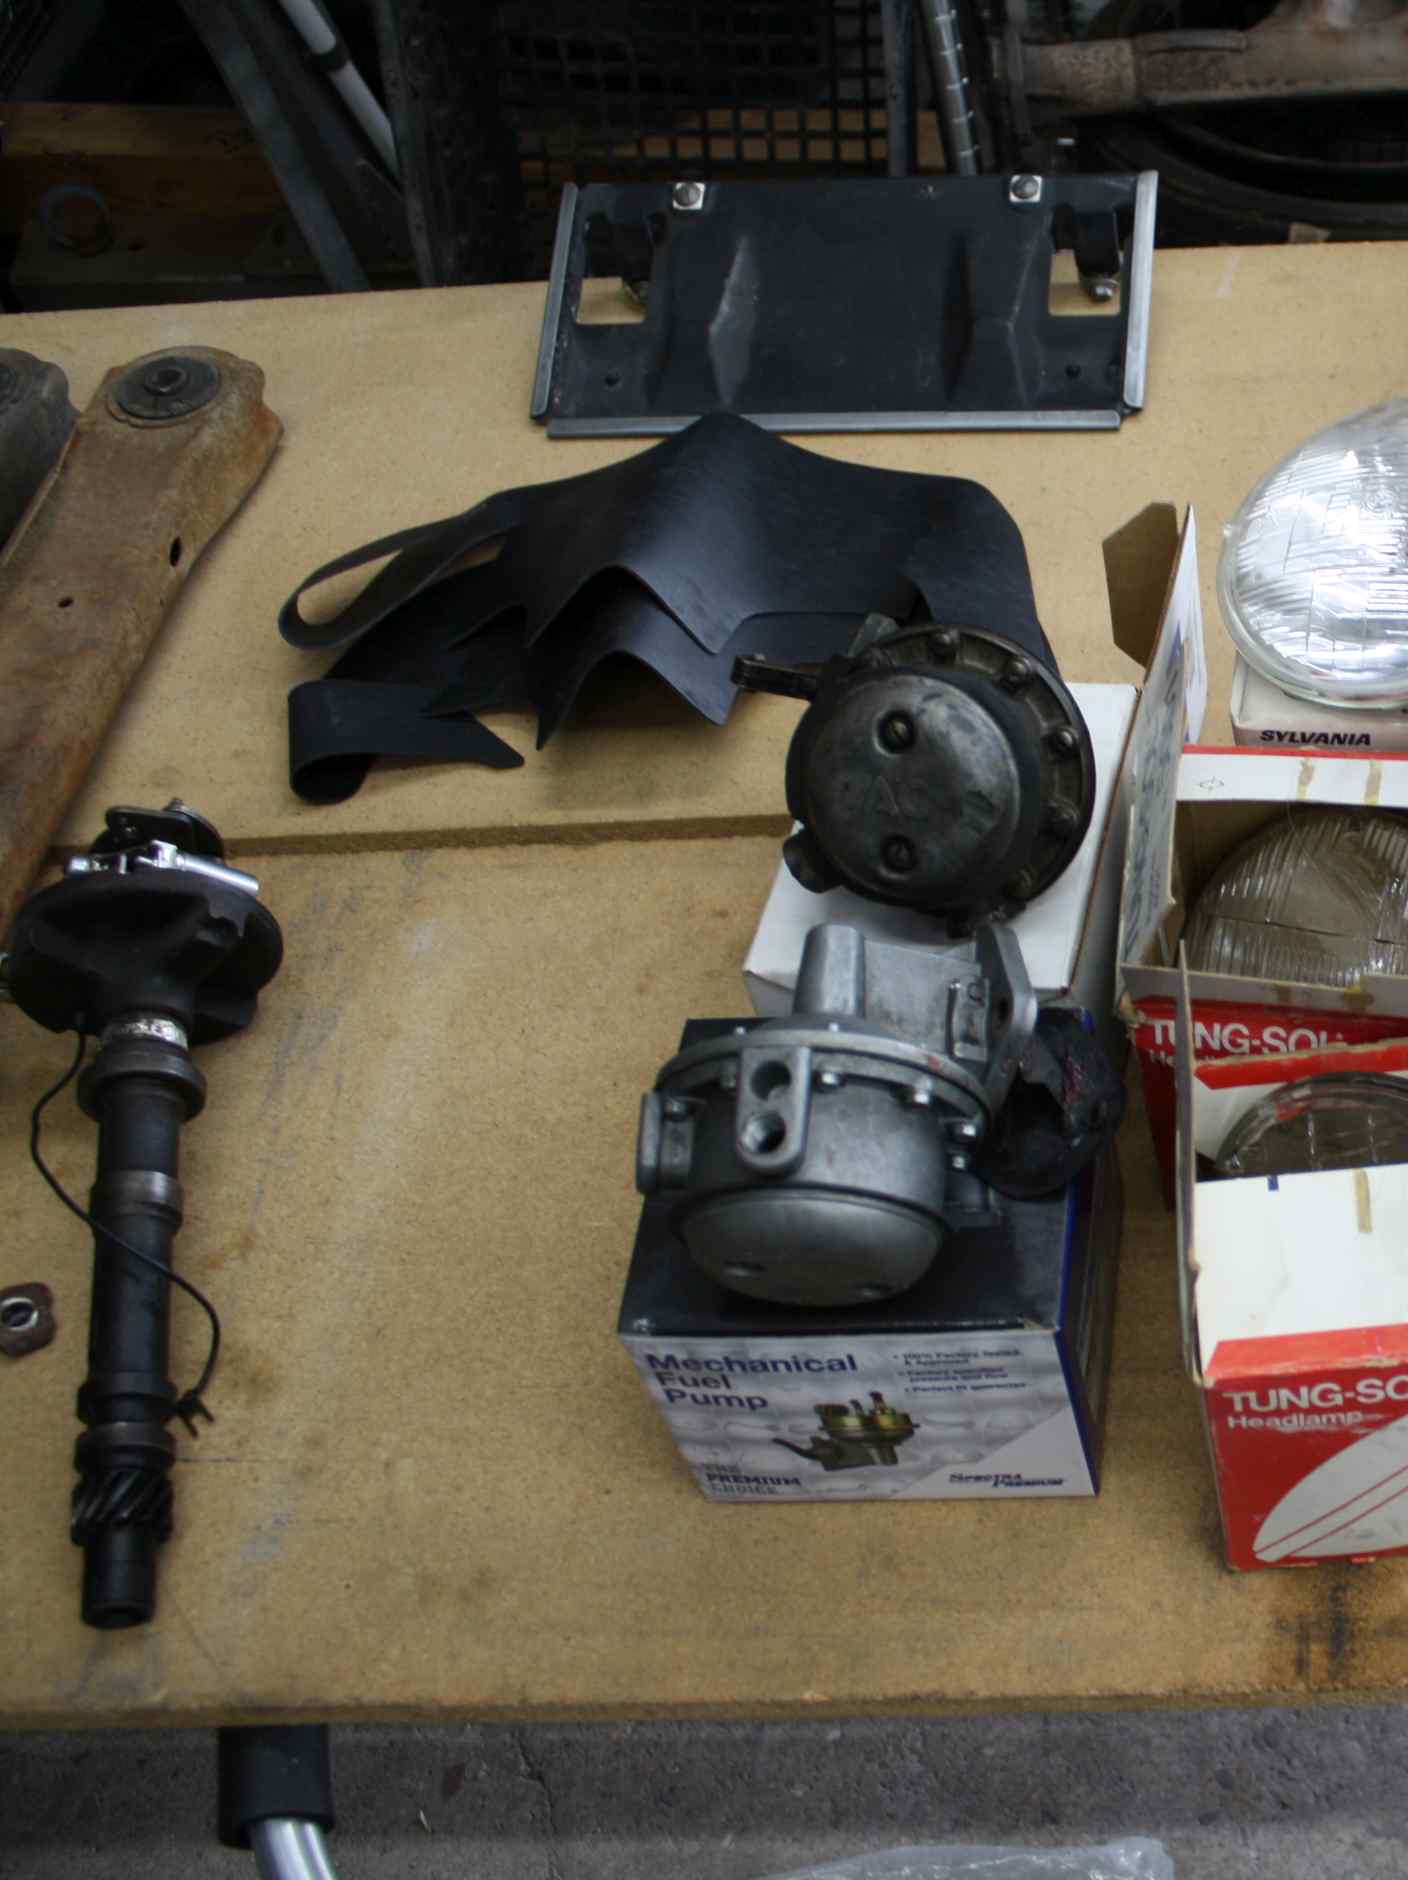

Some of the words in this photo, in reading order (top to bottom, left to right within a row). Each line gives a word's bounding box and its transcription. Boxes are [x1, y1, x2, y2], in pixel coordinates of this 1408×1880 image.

[1260, 729, 1372, 746] SYLVANIA
[645, 1353, 858, 1374] Mechanical
[655, 1371, 733, 1390] Fuel
[664, 1388, 769, 1411] Pump
[1227, 1410, 1364, 1430] Headlamp
